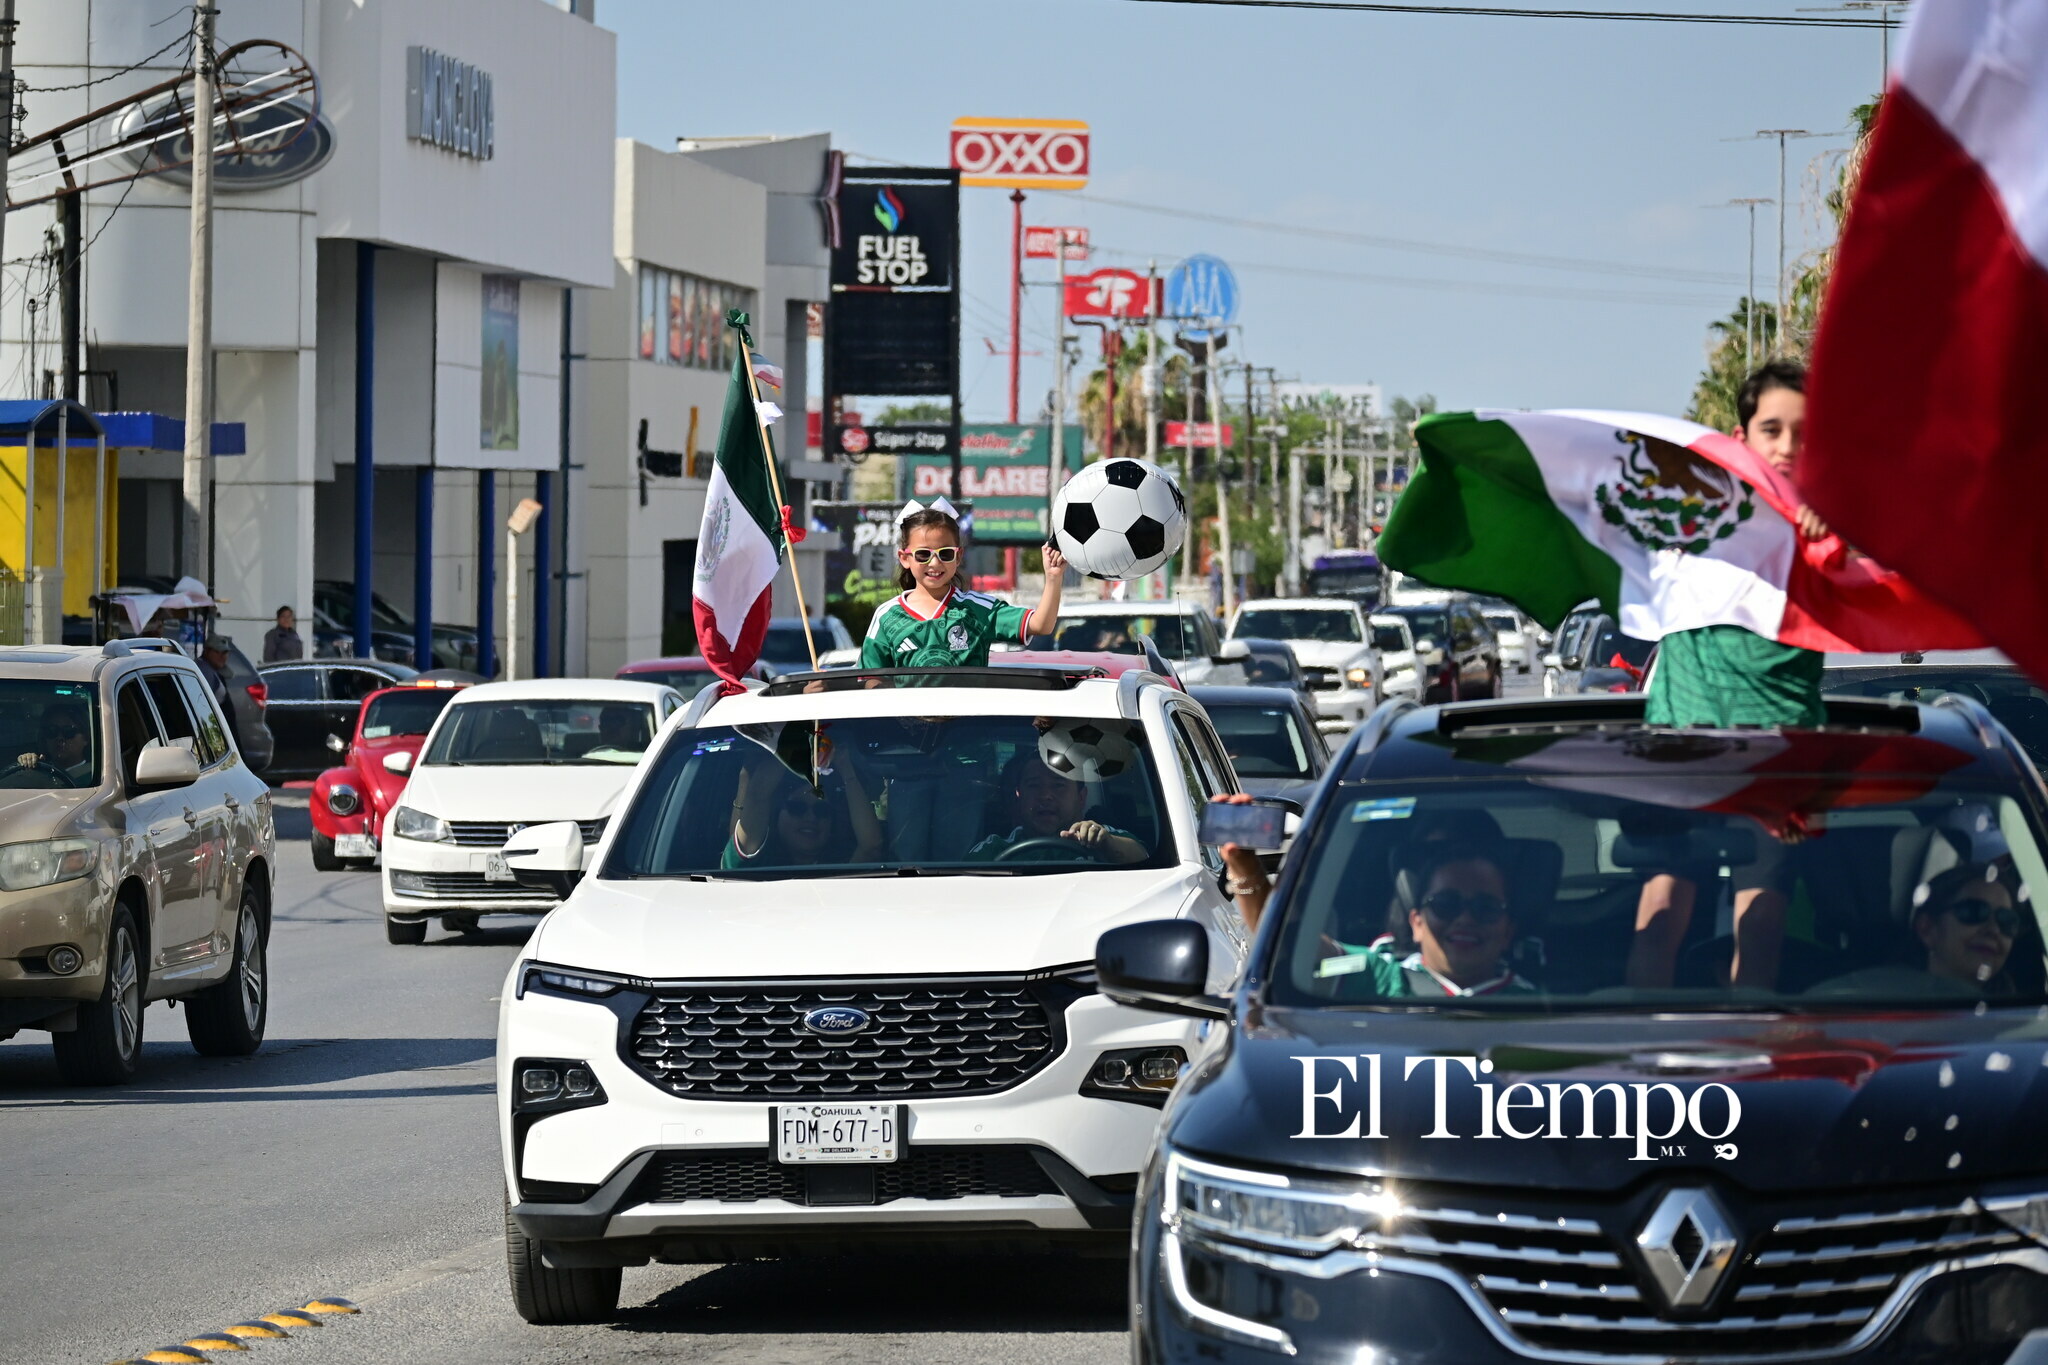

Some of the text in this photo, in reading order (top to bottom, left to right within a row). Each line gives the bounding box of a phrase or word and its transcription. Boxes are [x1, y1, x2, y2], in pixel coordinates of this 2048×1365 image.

[414, 46, 494, 161] MONCLOVA
[955, 131, 1085, 174] OXXO
[858, 234, 926, 261] FUEL
[858, 259, 928, 284] STOP
[914, 430, 947, 451] Stop
[819, 1013, 855, 1028] Ford
[811, 1106, 862, 1118] COAHUILA
[783, 1119, 892, 1144] FDM-677-D
